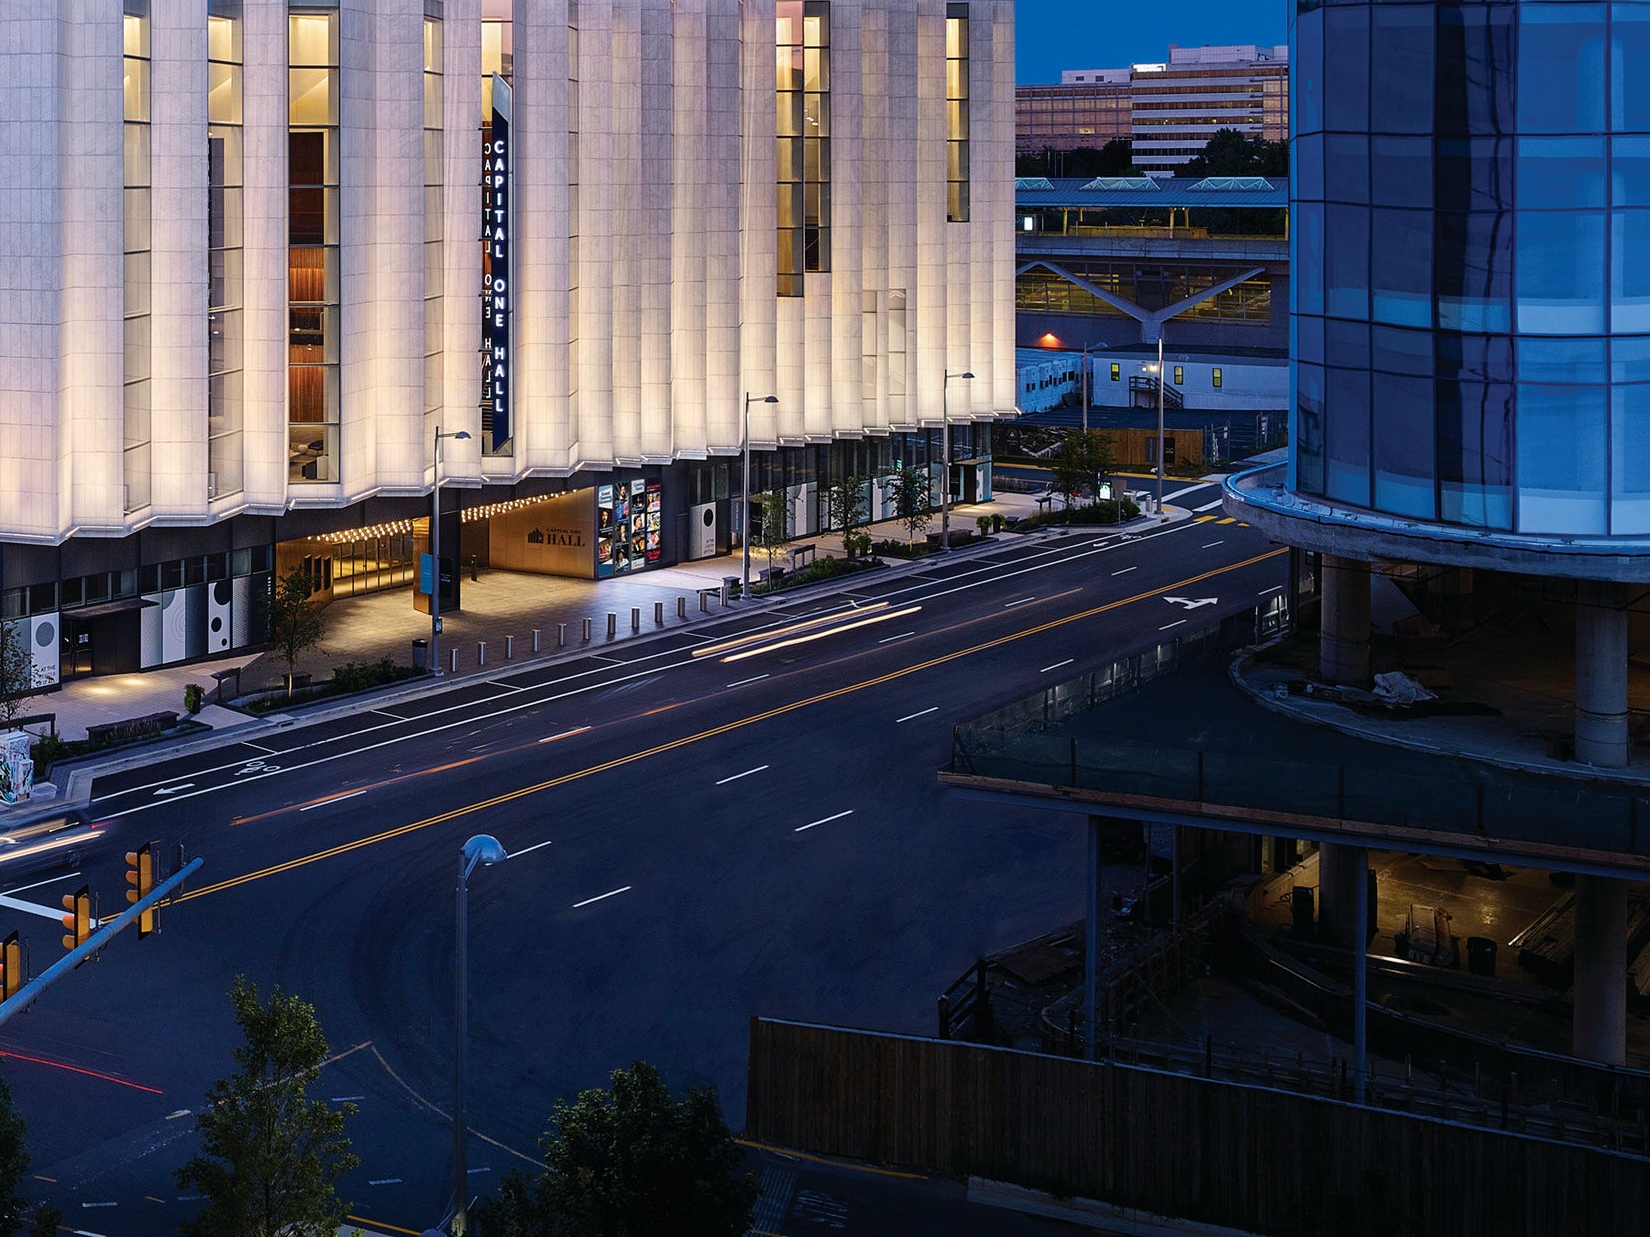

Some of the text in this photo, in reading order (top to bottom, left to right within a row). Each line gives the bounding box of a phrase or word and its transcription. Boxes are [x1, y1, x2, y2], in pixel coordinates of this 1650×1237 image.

[493, 140, 505, 412] CAPITAL ONE HALL
[547, 533, 586, 547] HALL
